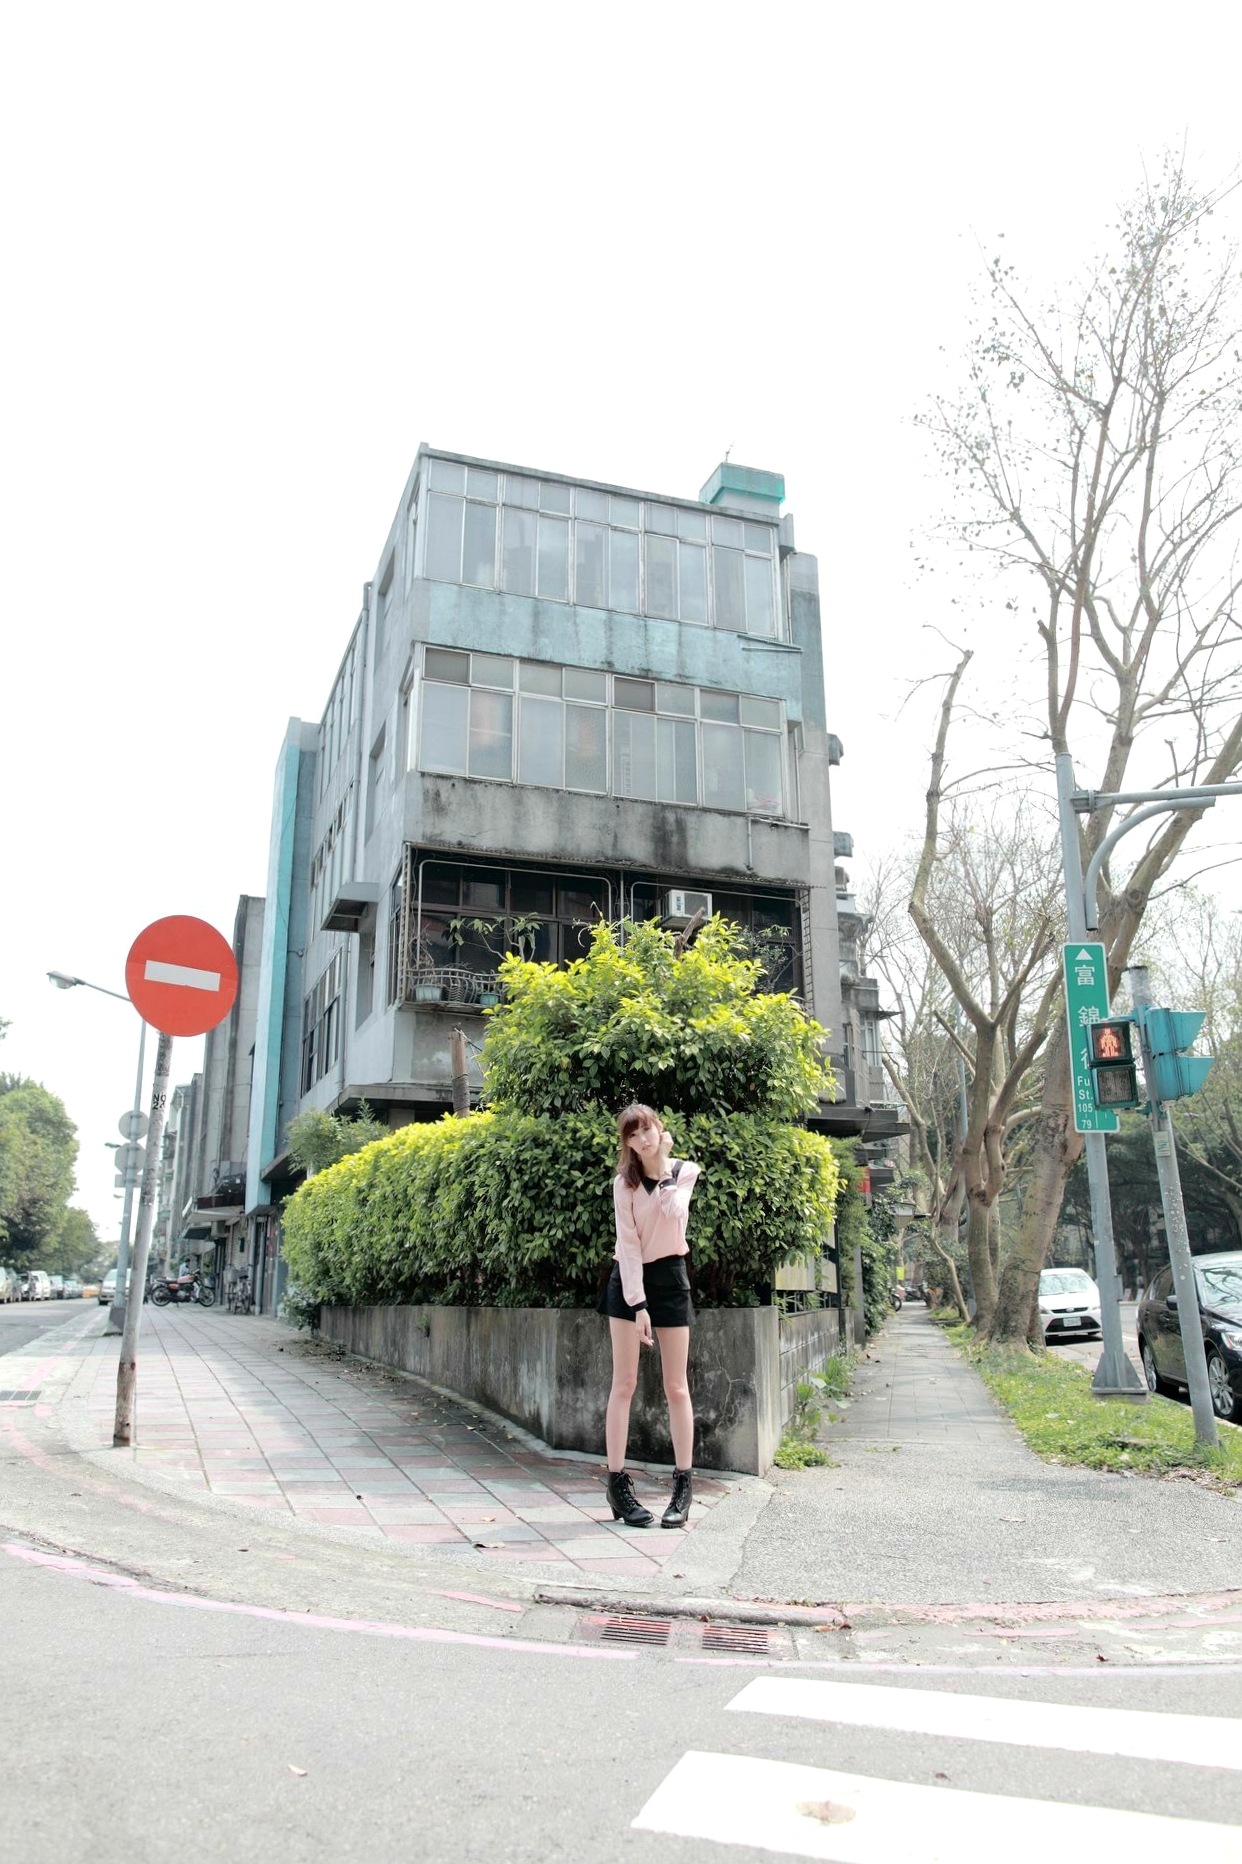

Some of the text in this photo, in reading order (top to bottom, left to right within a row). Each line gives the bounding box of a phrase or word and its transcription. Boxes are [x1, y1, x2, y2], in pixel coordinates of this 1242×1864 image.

[1078, 1089, 1093, 1100] St.
[1077, 1103, 1093, 1113] 105
[1081, 1119, 1092, 1129] 79
